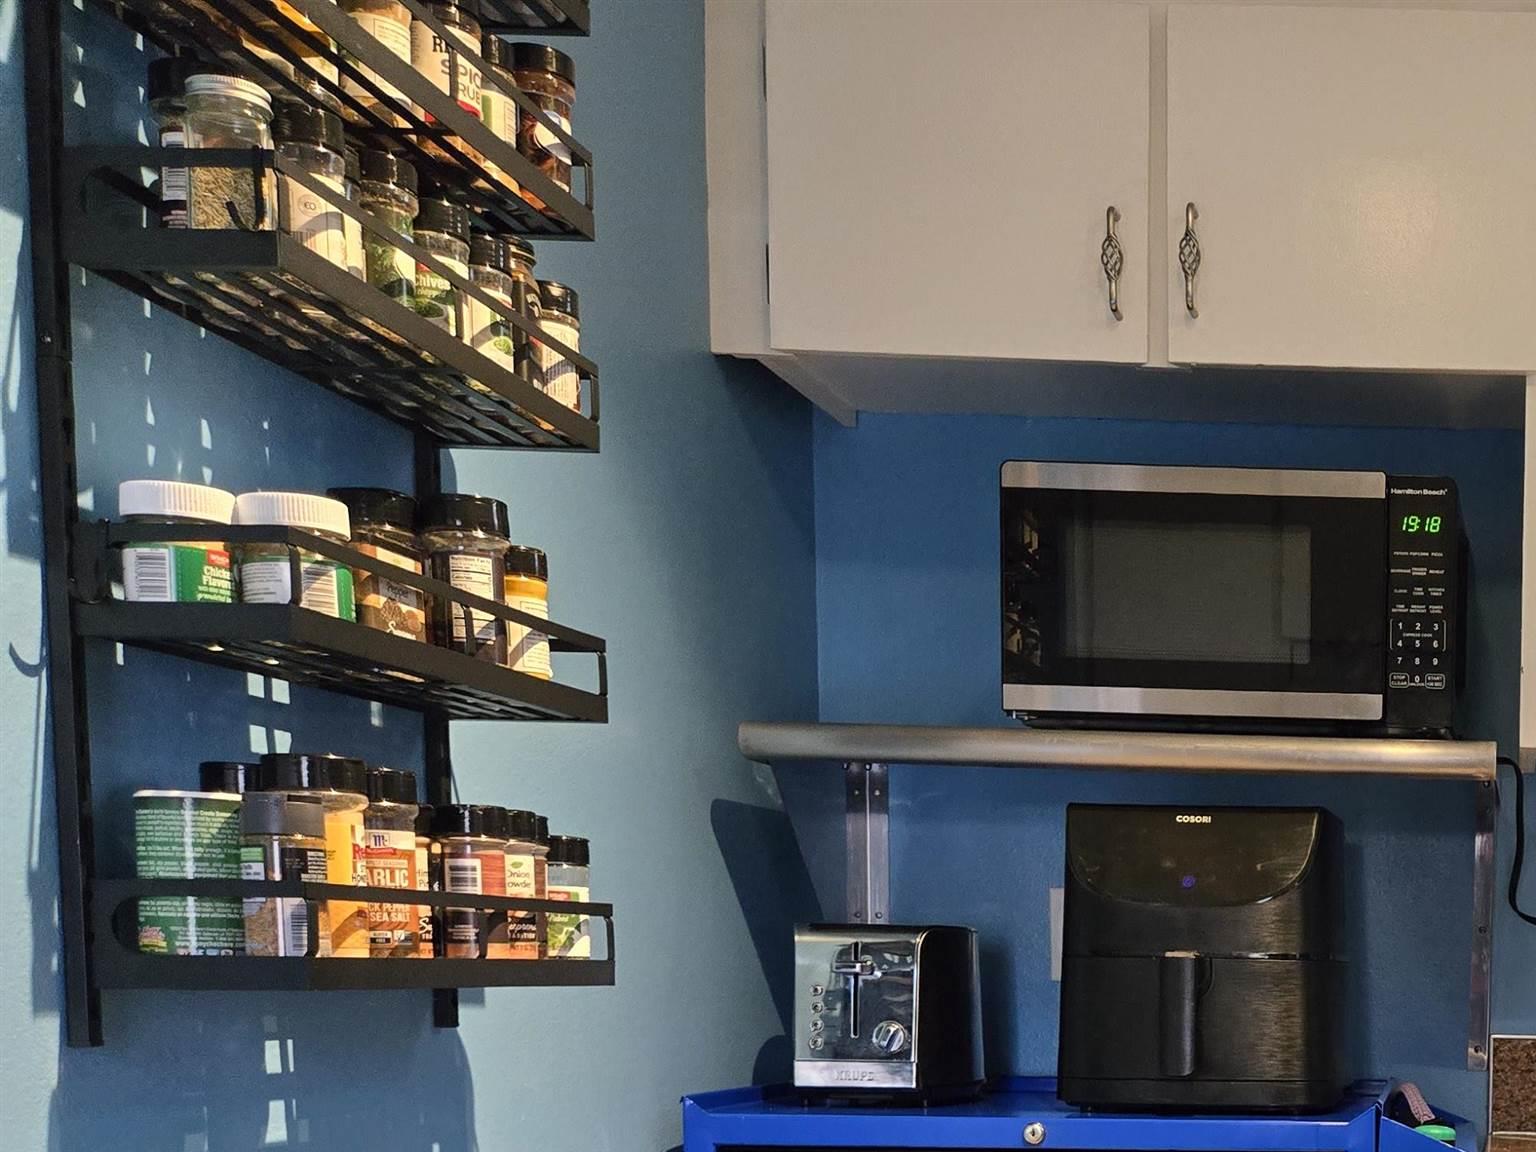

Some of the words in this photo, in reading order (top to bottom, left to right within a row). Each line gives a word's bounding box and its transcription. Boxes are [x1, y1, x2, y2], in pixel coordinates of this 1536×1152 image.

[416, 272, 451, 290] hives
[1402, 515, 1441, 532] 19:18
[1398, 622, 1403, 630] 1
[1415, 623, 1421, 631] 2
[1433, 623, 1439, 631] 3
[1415, 640, 1421, 648] 5
[1433, 640, 1439, 648] 6
[1415, 657, 1420, 665] 8
[1433, 658, 1439, 666] 9
[1414, 675, 1420, 683] 0
[1175, 815, 1211, 823] COSORI
[367, 868, 408, 887] ARLIC
[370, 912, 390, 921] SEA
[834, 1071, 875, 1081] KRUPS
